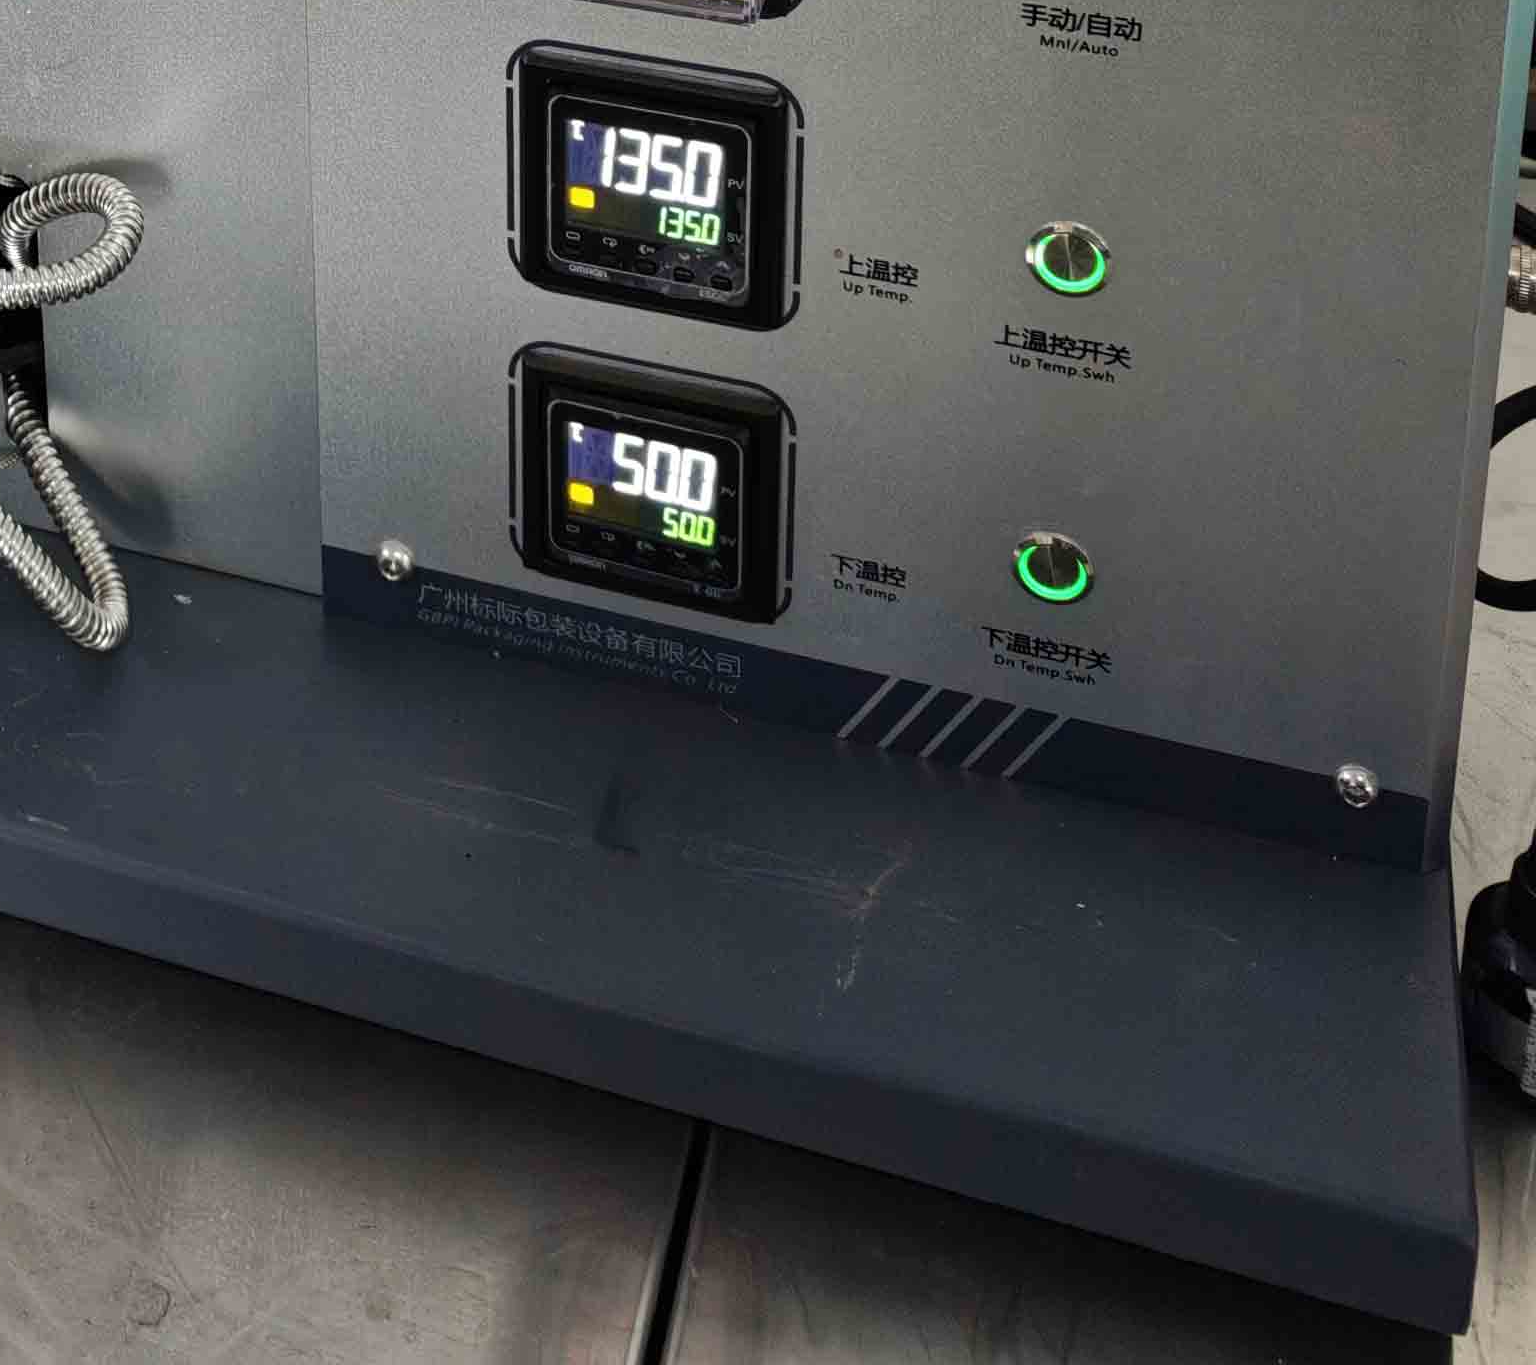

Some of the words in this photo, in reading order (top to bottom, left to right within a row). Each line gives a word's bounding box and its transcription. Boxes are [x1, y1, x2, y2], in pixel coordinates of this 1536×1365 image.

[1021, 2, 1144, 43] 手动/自动
[839, 253, 920, 288] 上温控
[842, 280, 865, 298] Up
[994, 324, 1133, 370] 上温控开关
[1008, 353, 1031, 370] Up
[831, 553, 907, 589] 下温控
[833, 578, 855, 593] Dn
[981, 625, 1113, 674] 下温控开关
[993, 654, 1015, 669] Dn
